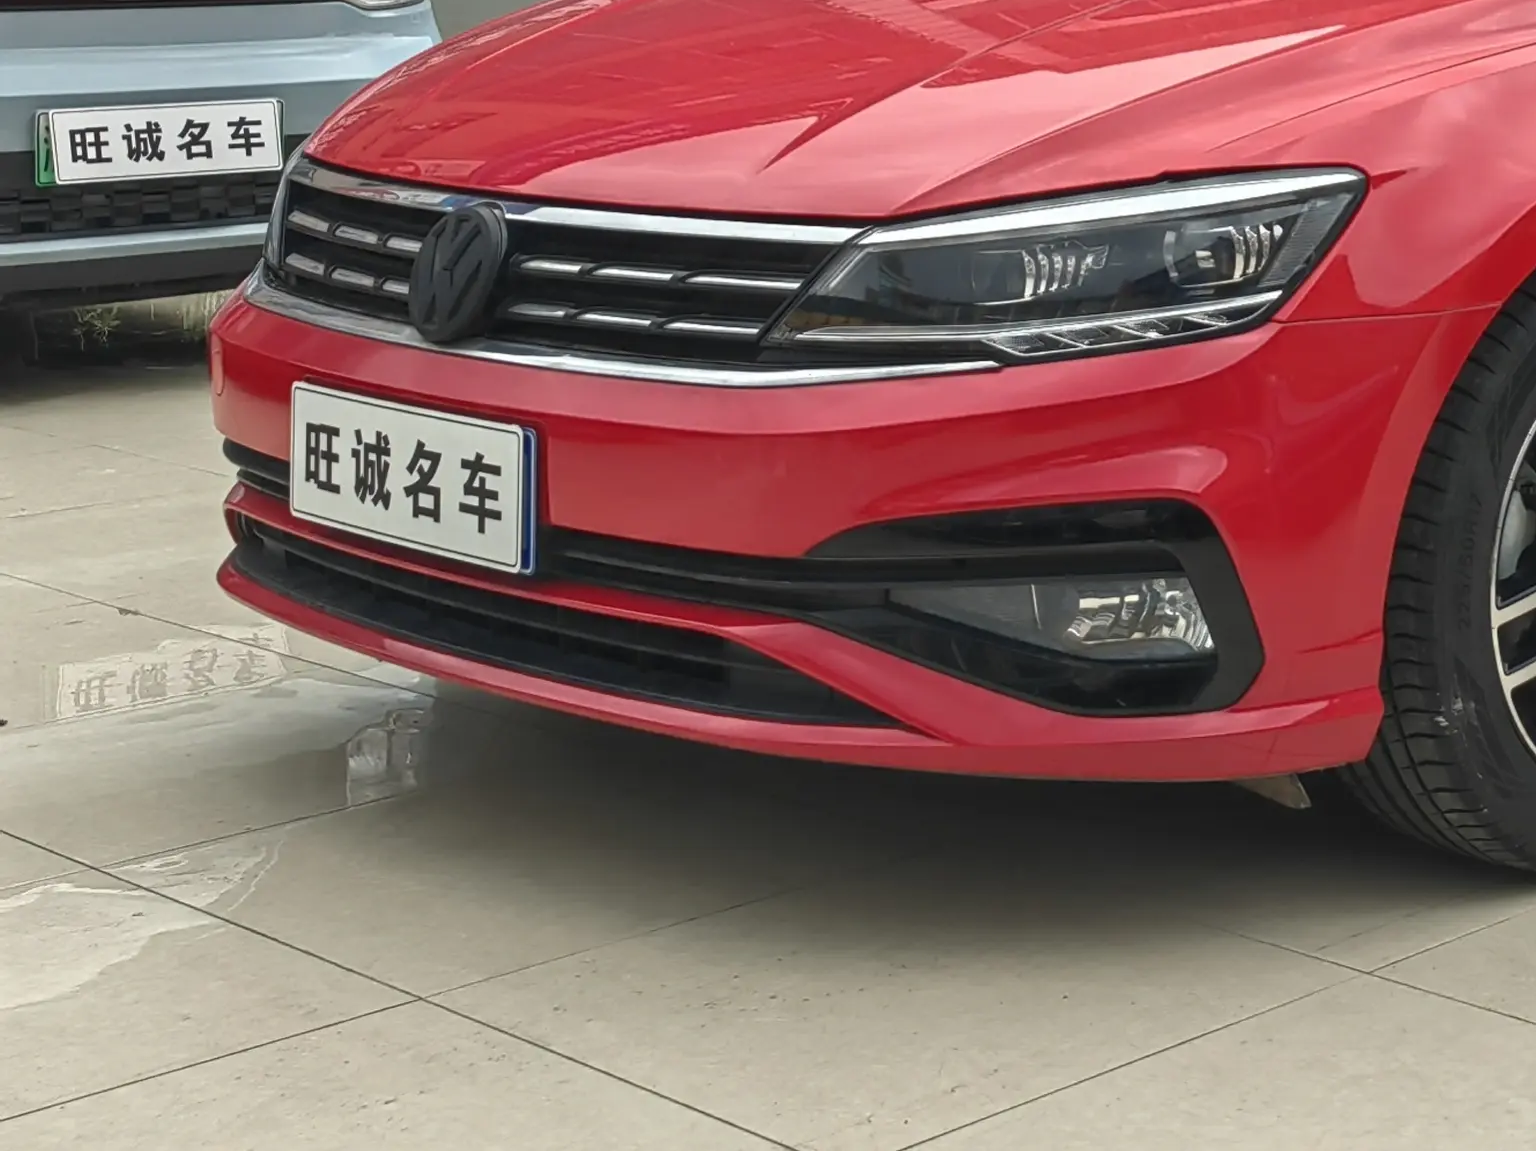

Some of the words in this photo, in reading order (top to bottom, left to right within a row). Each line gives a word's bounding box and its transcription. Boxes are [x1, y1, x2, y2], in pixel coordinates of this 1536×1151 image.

[69, 116, 265, 165] 旺诚名车
[305, 422, 502, 535] 旺诚名车
